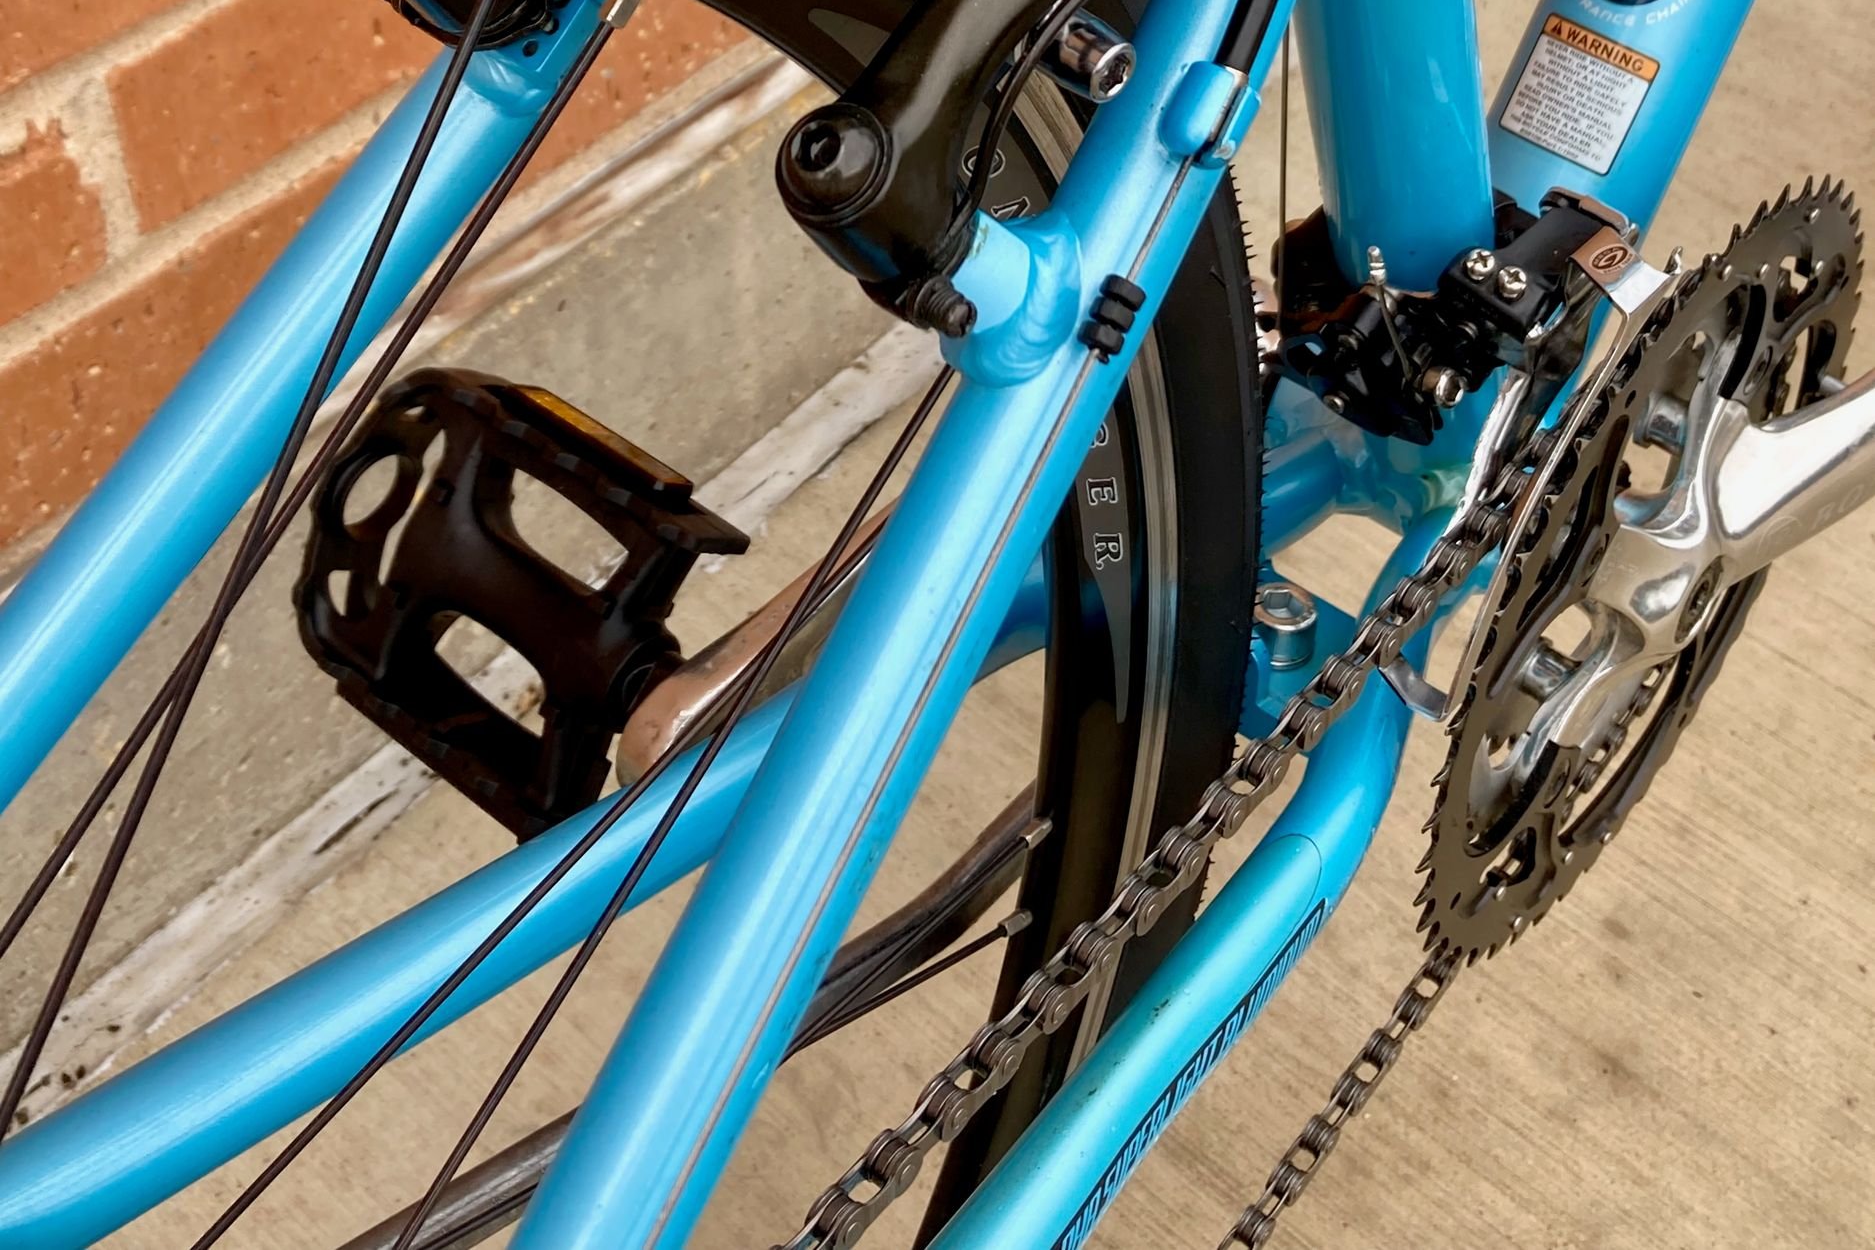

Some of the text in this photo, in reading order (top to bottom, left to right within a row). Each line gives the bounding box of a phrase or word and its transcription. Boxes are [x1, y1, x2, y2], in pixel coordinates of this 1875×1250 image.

[1563, 26, 1645, 73] WARNING
[1547, 57, 1580, 78] WITHOUT
[1575, 61, 1587, 71] OR
[1588, 67, 1600, 77] AT
[1588, 58, 1625, 80] WITHOUT
[1545, 75, 1575, 93] RESULT
[1562, 74, 1572, 83] TO
[1593, 88, 1626, 108] SAFELY
[1562, 92, 1575, 103] OR
[1539, 110, 1560, 124] HAVE
[1543, 103, 1560, 115] YOU
[1535, 117, 1557, 132] YOUR
[1103, 1028, 1223, 1206] SUPERLIGHT
